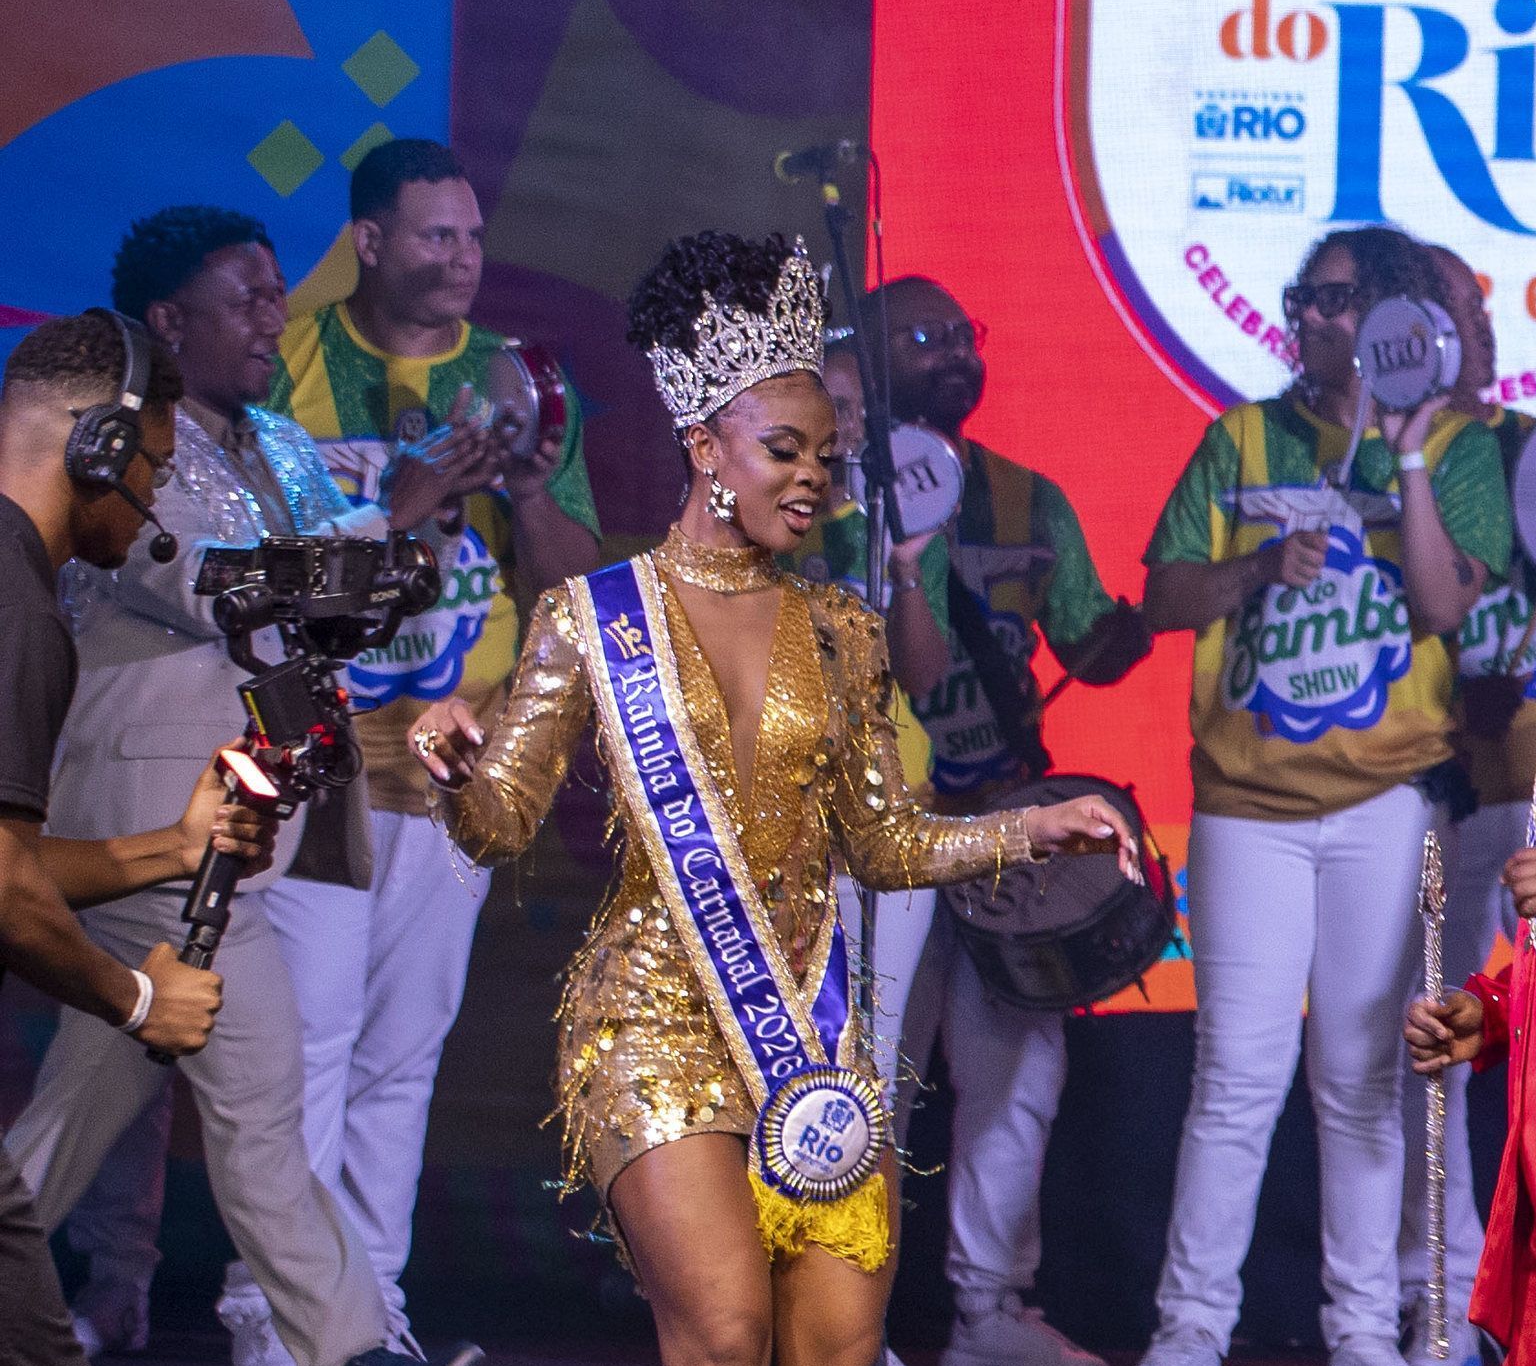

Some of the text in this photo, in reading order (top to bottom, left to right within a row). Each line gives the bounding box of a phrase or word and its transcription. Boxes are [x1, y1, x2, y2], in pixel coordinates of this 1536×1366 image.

[1232, 105, 1306, 140] RIO
[1288, 664, 1361, 701] SHOW
[615, 666, 805, 1079] Rainha do Carnaval 2026
[799, 1124, 843, 1163] Rio
